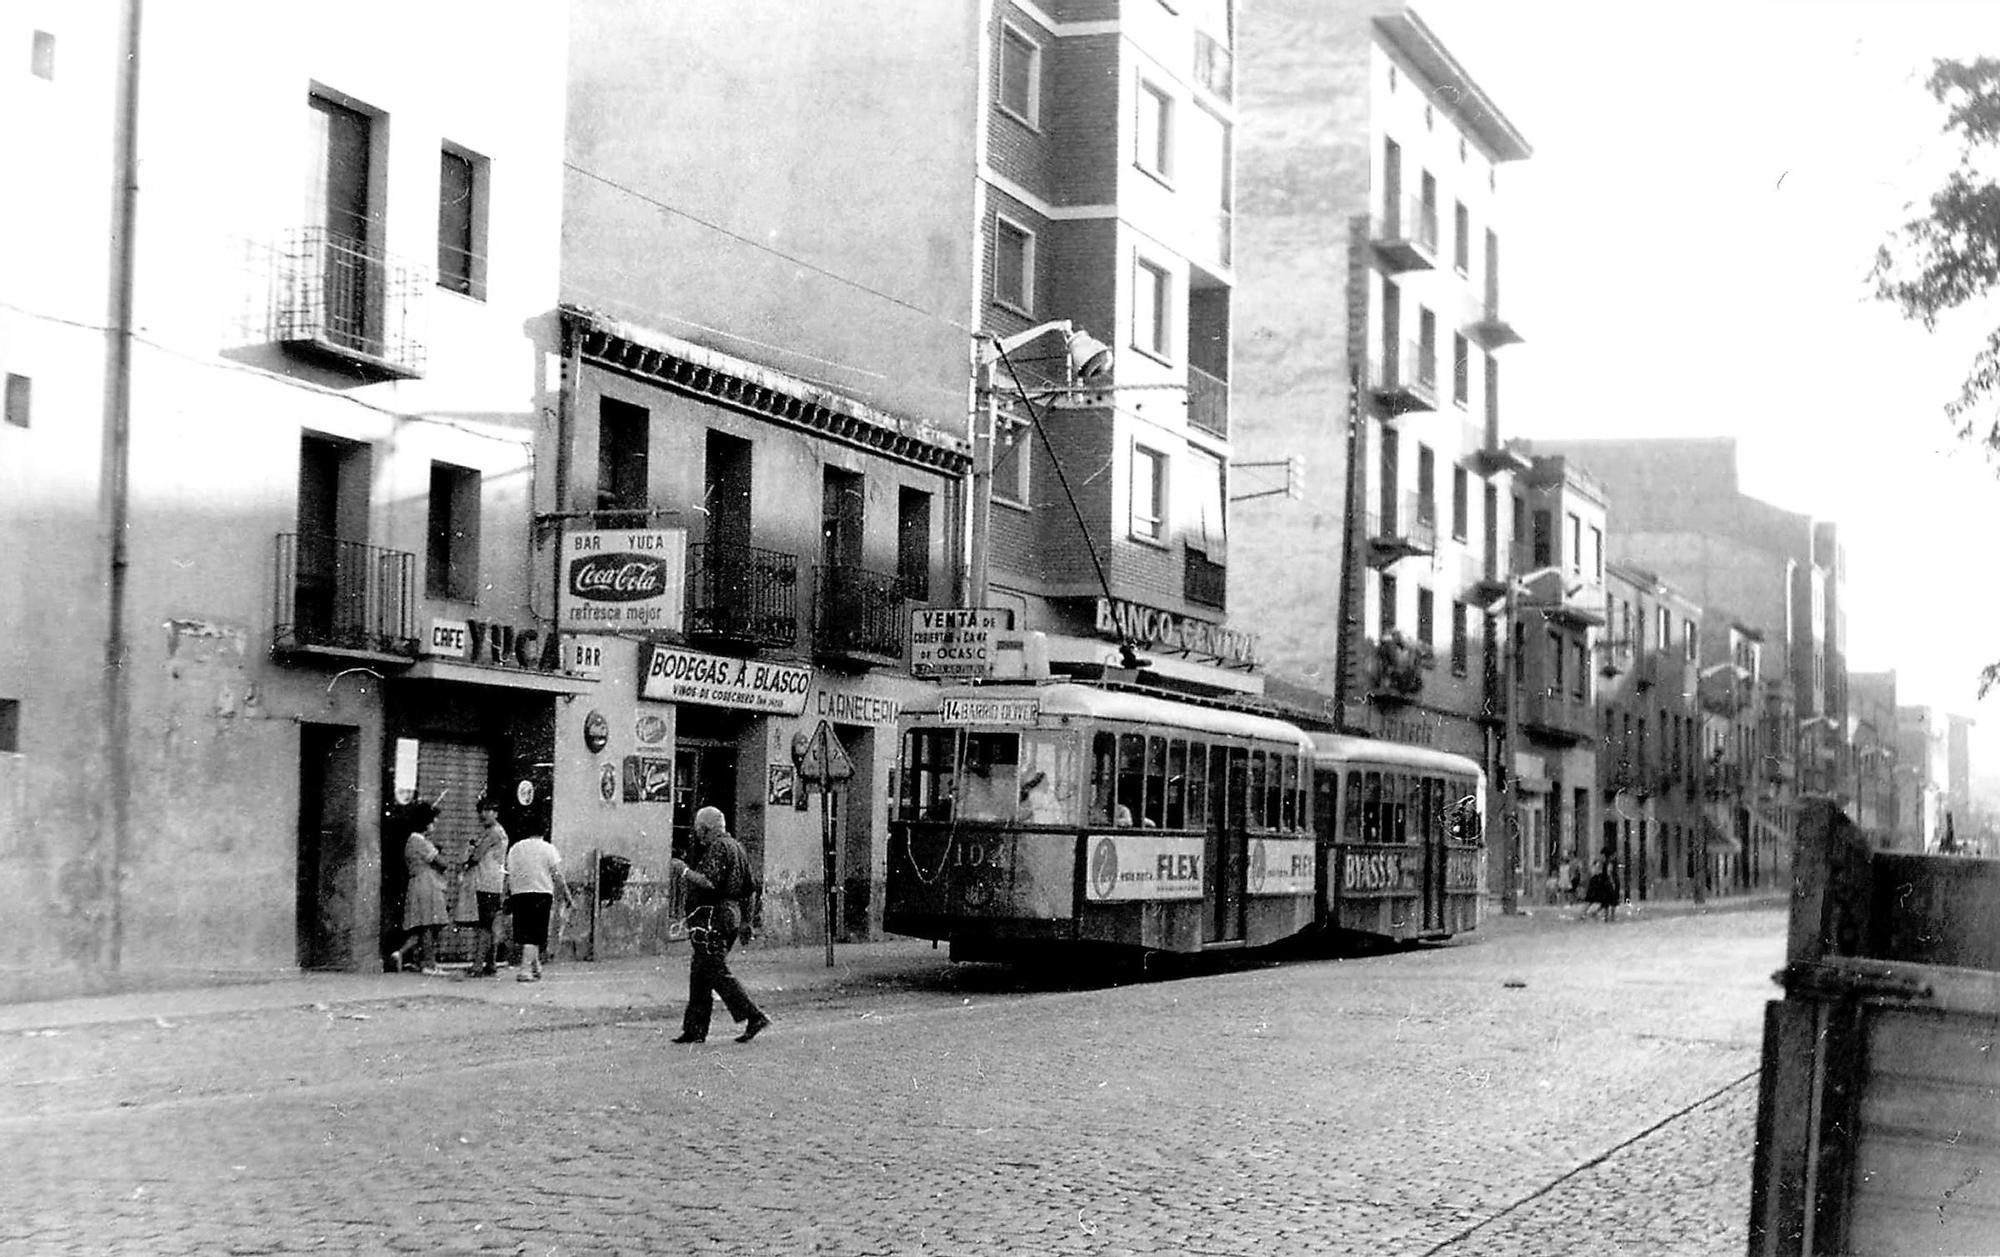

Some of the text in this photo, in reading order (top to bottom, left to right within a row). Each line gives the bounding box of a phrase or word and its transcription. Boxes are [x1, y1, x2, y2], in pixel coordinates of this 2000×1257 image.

[575, 535, 664, 550] BAR YUCA
[570, 602, 662, 625] refresca mejor
[923, 611, 996, 628] VENTA DE
[1096, 598, 1173, 644] BANCO
[433, 619, 561, 673] CAFE YUCA
[576, 646, 601, 667] BAR
[753, 667, 810, 695] BLASCO
[673, 684, 697, 698] VINOS
[711, 690, 754, 706] COSECHERO
[945, 700, 960, 720] 14
[1157, 854, 1201, 881] FLEX
